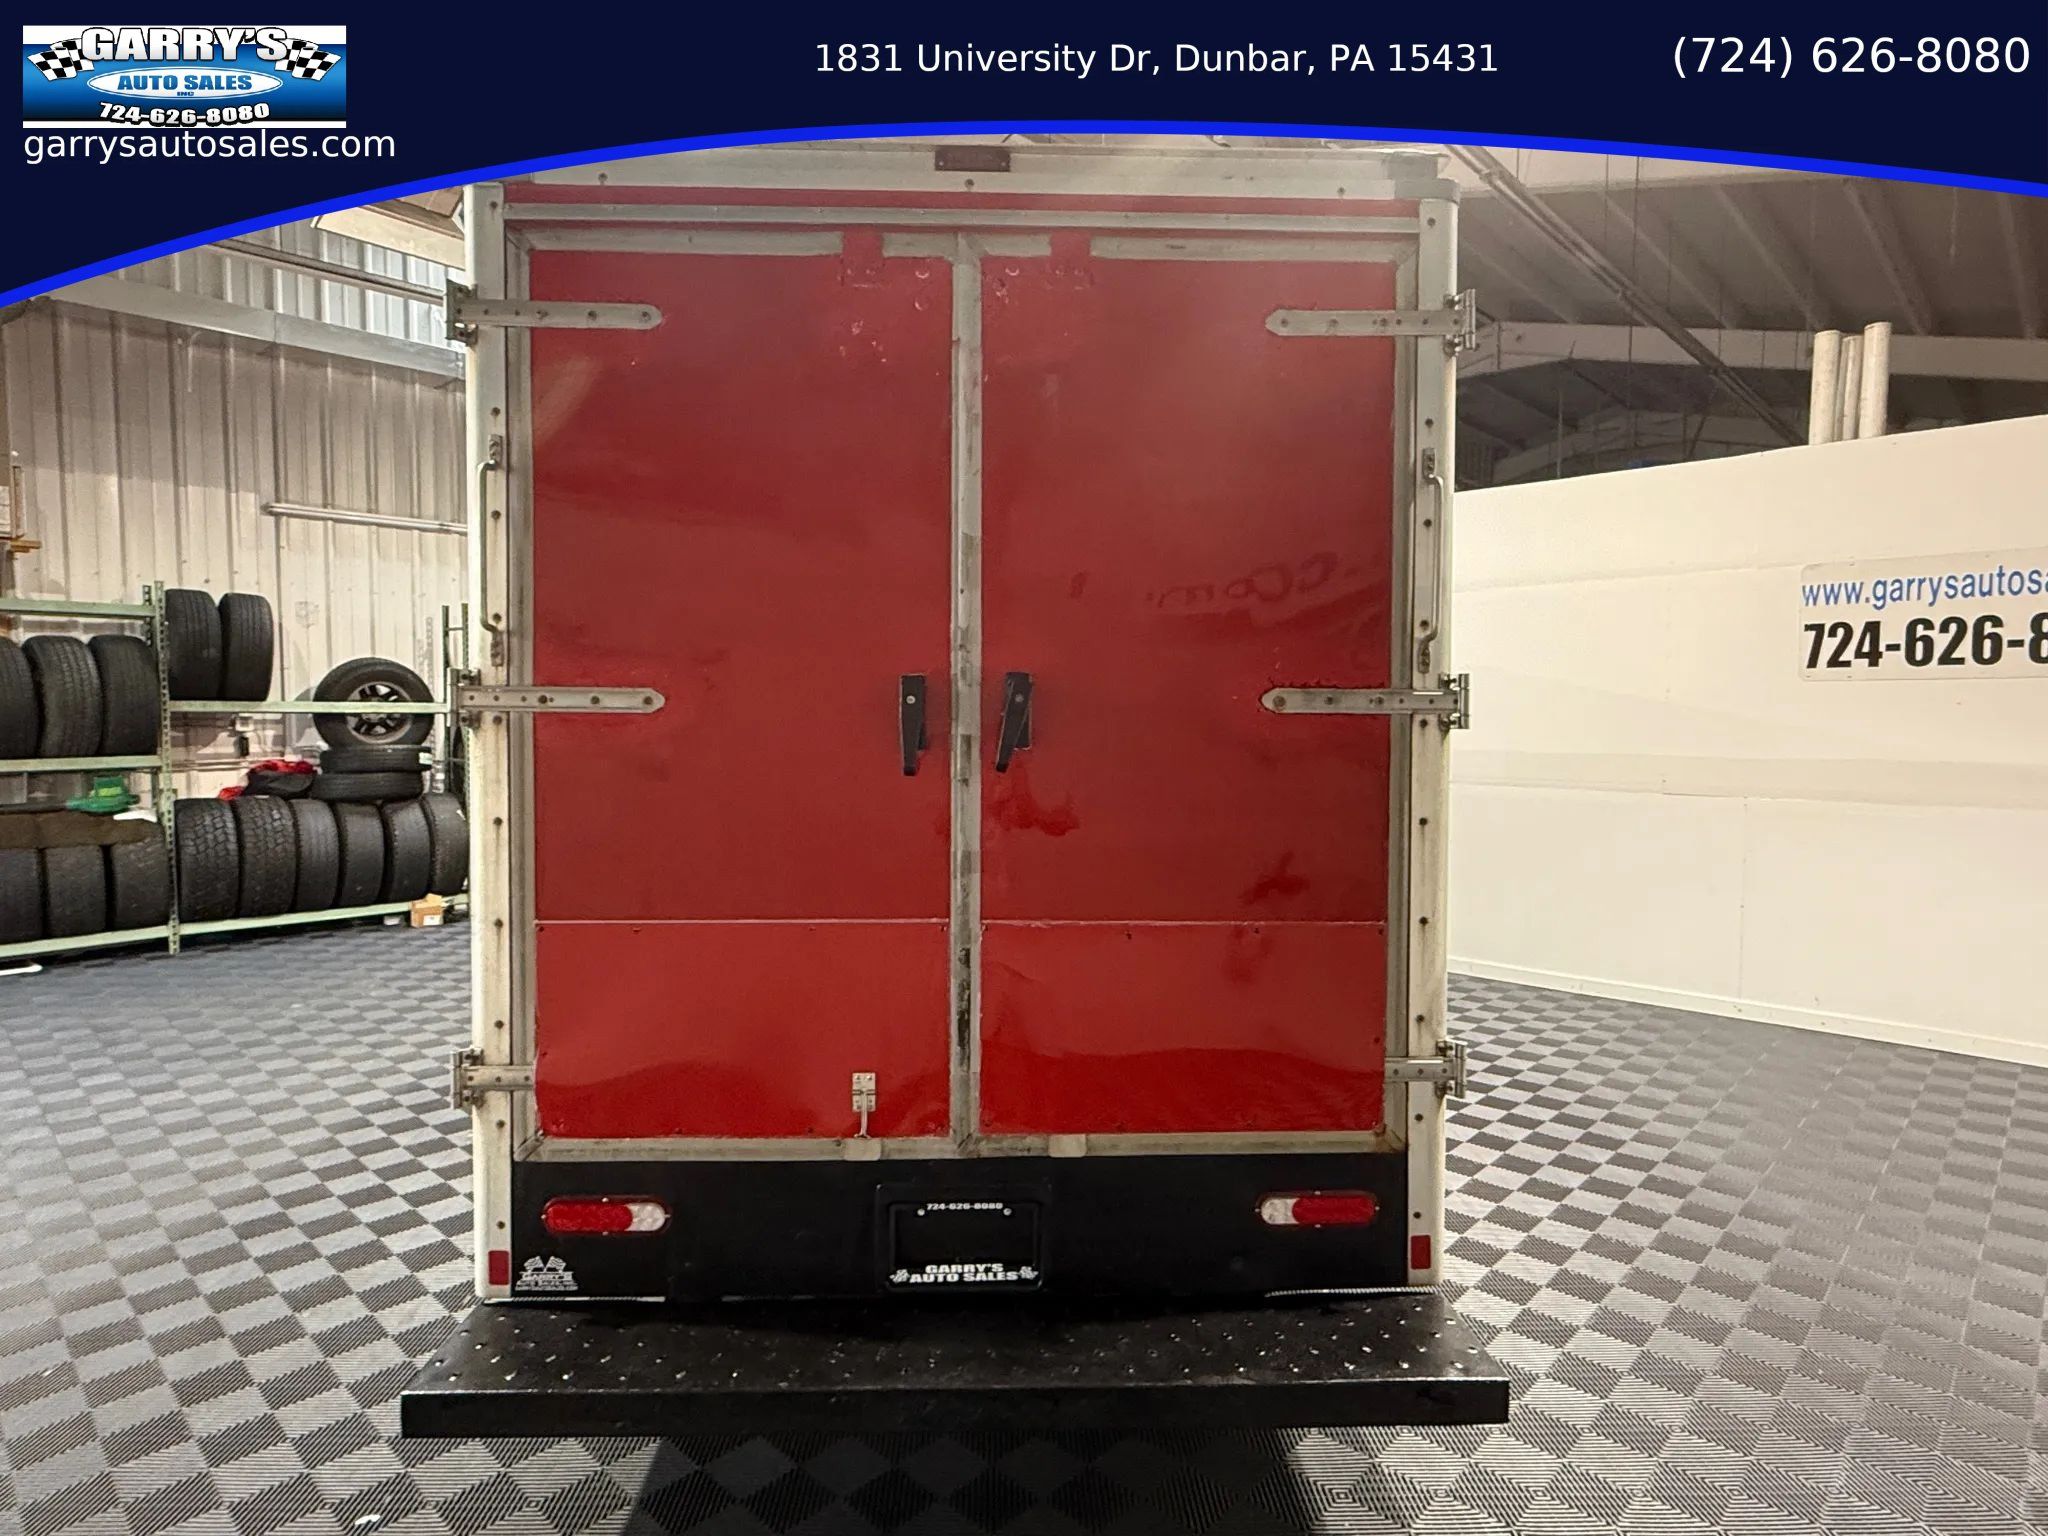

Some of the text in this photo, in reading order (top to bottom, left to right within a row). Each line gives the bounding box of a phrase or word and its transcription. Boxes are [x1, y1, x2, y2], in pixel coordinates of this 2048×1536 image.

[1802, 565, 2048, 611] www.garrysautos
[924, 1263, 1004, 1274] GARRY'S
[909, 1271, 1019, 1283] AUTO SALES
